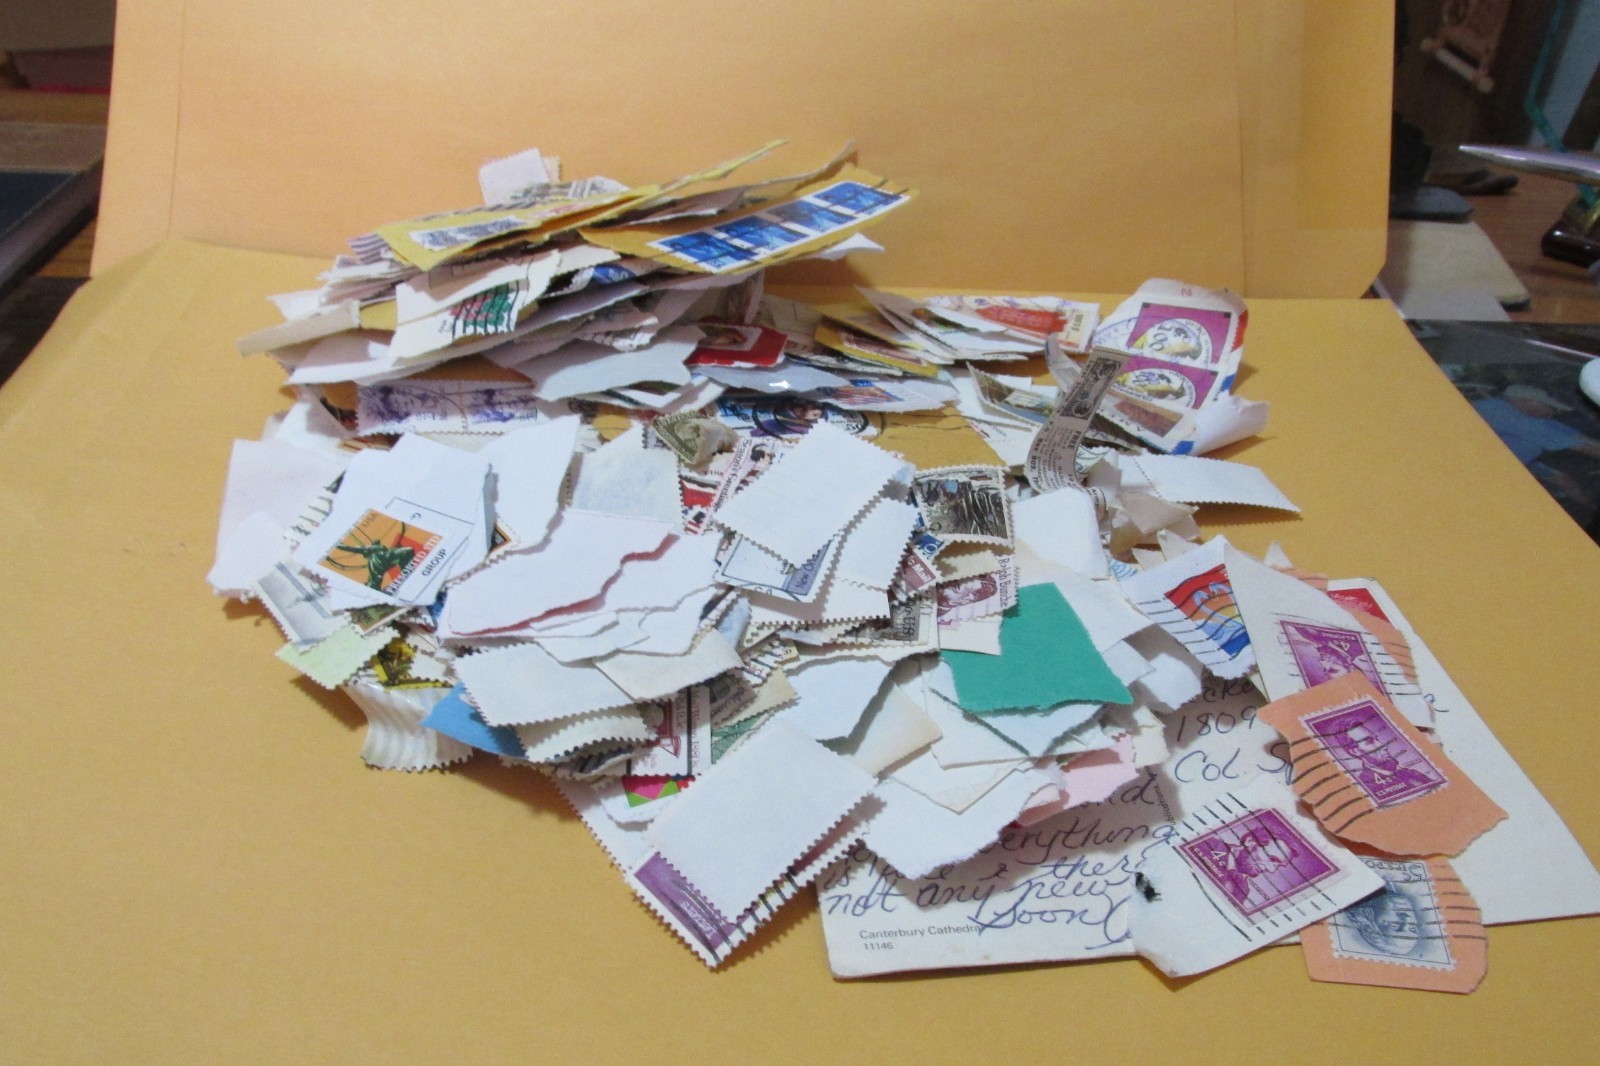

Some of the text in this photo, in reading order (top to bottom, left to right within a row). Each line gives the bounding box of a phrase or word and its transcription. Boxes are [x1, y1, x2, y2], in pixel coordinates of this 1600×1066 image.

[421, 548, 446, 577] GROUP
[1177, 705, 1257, 742] 1809
[859, 928, 925, 940] Canterbury
[864, 942, 894, 951] 11146
